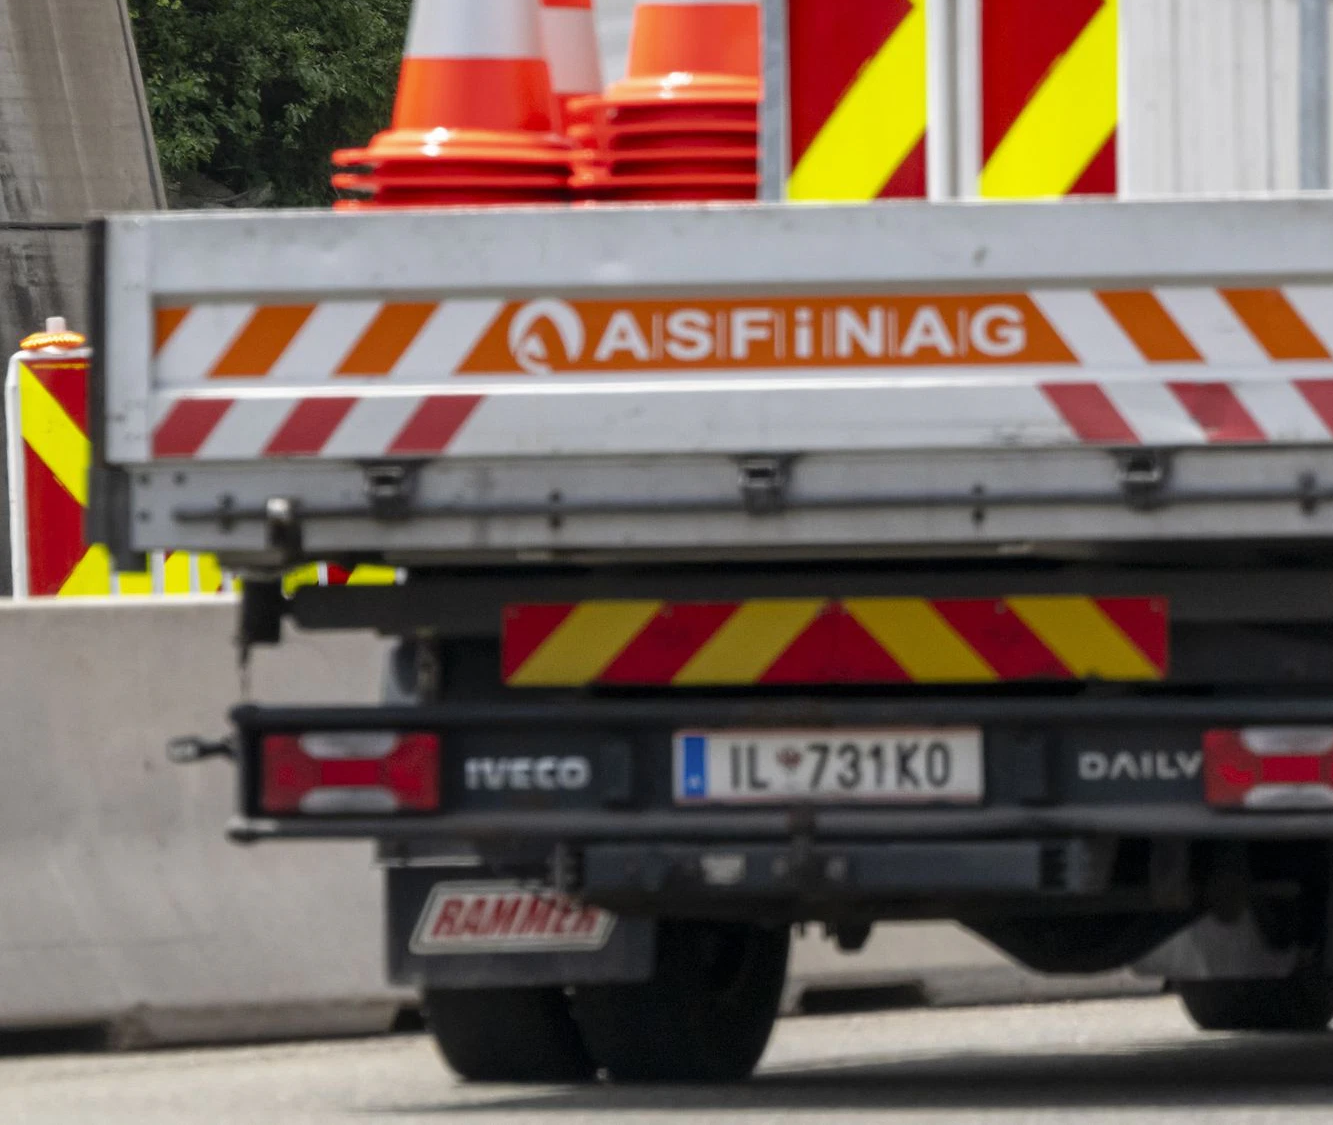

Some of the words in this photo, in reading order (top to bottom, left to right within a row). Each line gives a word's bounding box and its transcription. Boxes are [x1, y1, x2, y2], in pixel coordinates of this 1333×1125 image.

[465, 755, 592, 790] IVECO
[729, 744, 769, 790] IL
[431, 895, 600, 937] RAMMER
